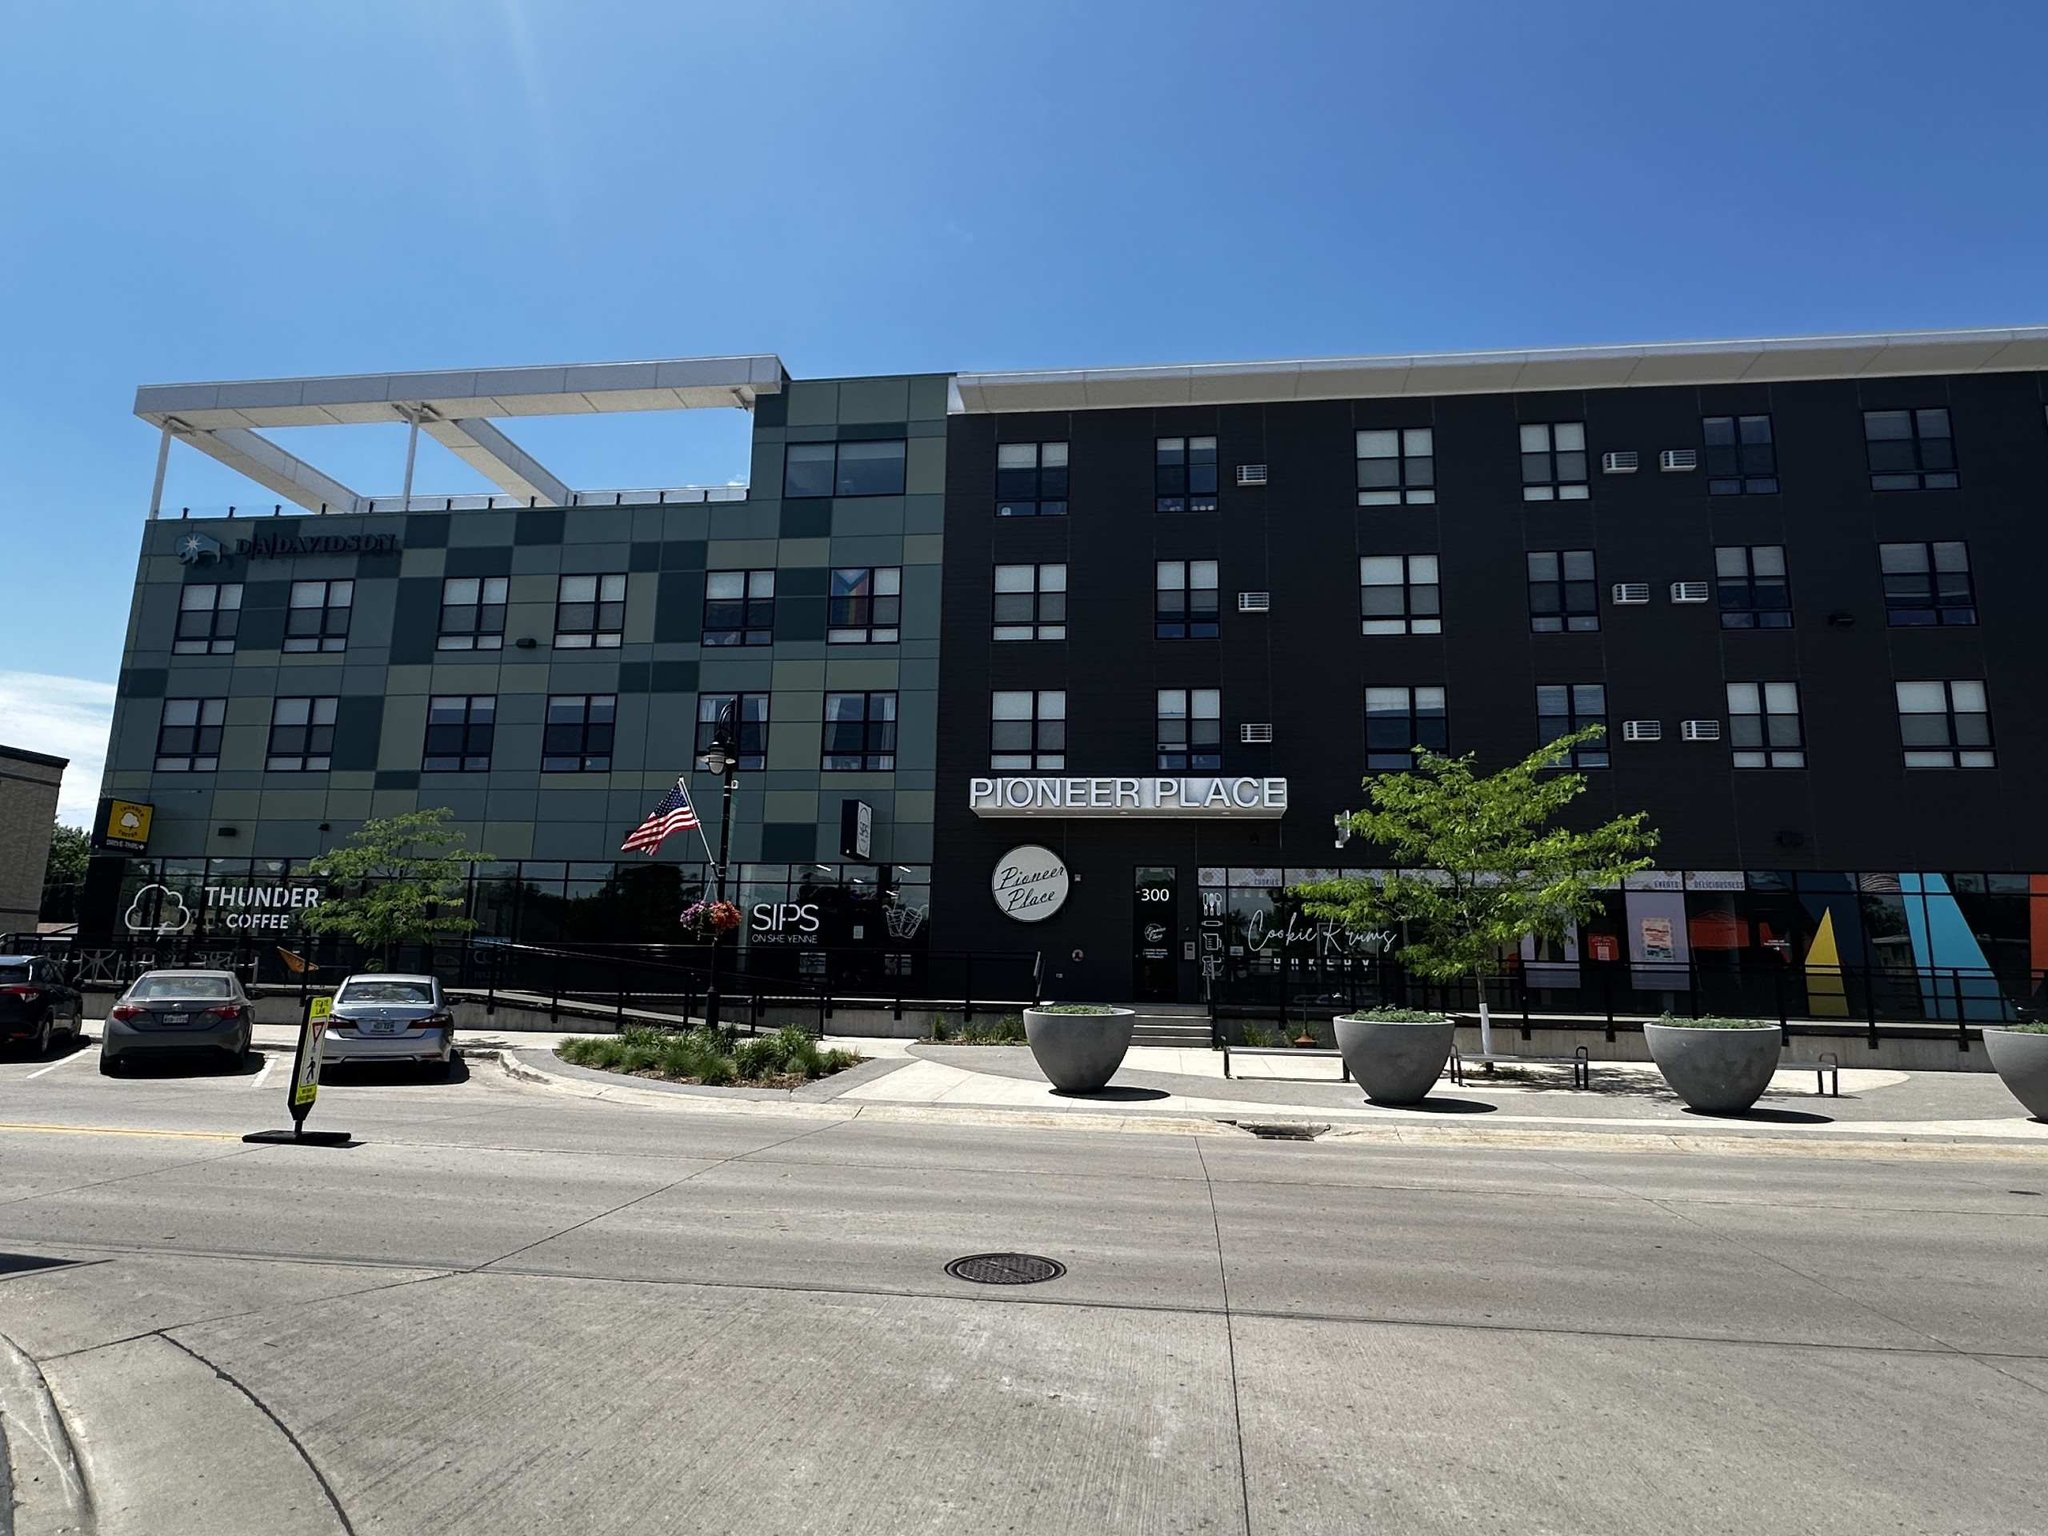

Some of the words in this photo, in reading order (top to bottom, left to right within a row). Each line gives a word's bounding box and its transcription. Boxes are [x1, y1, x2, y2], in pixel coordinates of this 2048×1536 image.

[970, 778, 1140, 807] PIONEER
[1154, 777, 1286, 808] PLACE
[1000, 866, 1064, 890] Pioneer
[204, 886, 319, 908] THUNDER
[1007, 888, 1055, 911] Place
[1141, 888, 1170, 902] 300
[226, 913, 289, 929] COFFEE
[751, 903, 820, 931] SIPS
[751, 934, 766, 943] ON
[1248, 909, 1317, 952] Cookie
